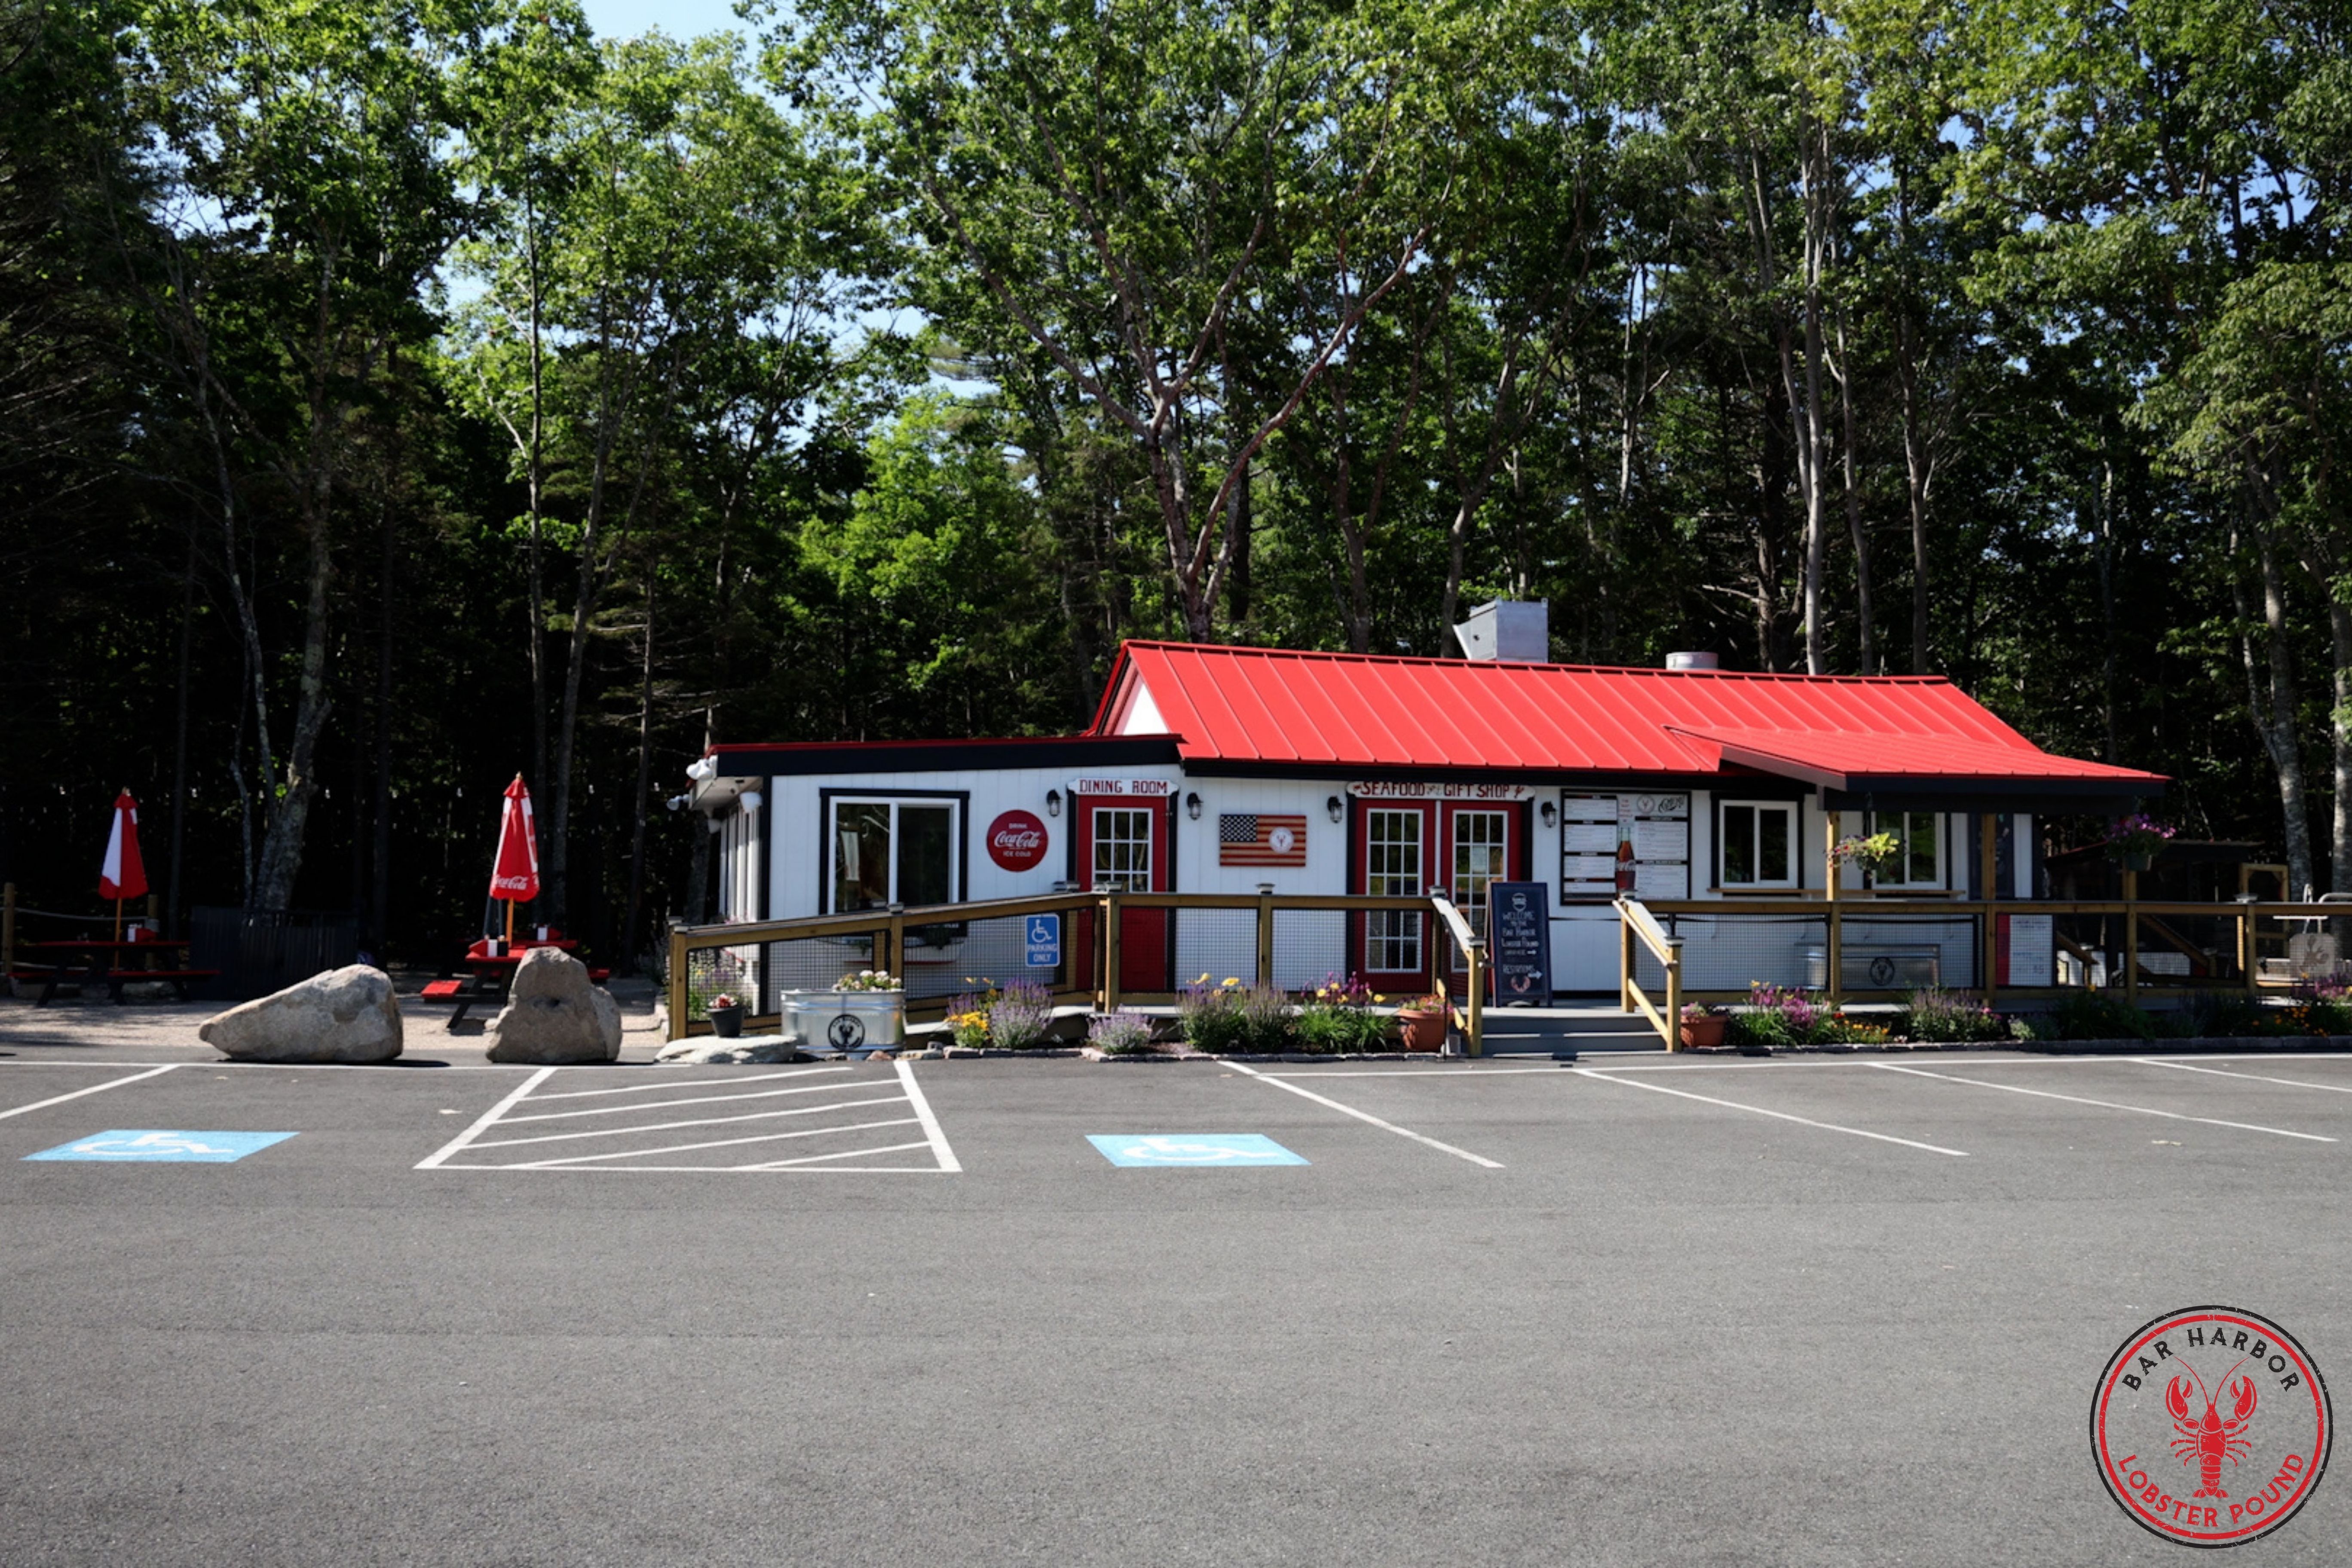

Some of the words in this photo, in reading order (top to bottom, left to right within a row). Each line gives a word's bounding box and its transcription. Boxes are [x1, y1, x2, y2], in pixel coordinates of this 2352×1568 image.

[1079, 779, 1123, 793] DINING
[1132, 781, 1168, 794] ROOM
[1360, 782, 1425, 796] SEAFOOD
[1444, 784, 1475, 797] GIFT
[1476, 785, 1510, 798] SHOP
[994, 830, 1041, 848] Coca-Cola
[1027, 943, 1058, 952] PARKING
[1033, 953, 1051, 962] ONLY
